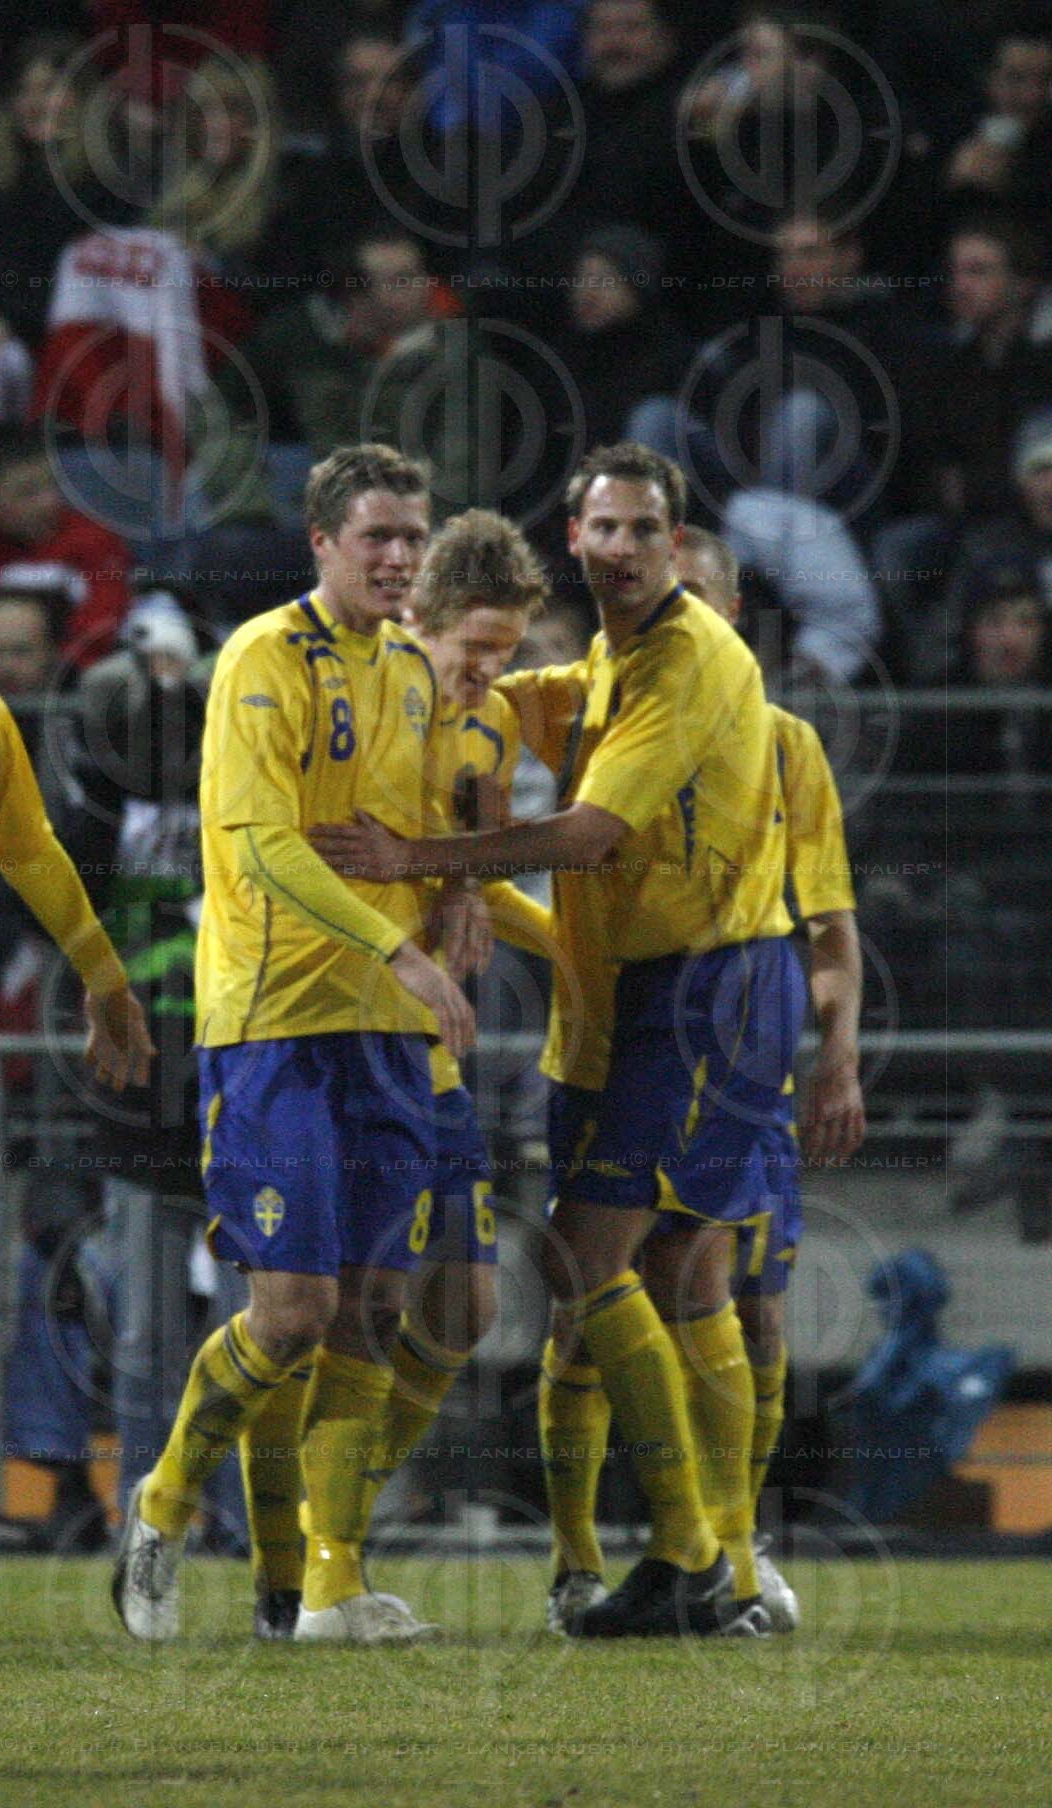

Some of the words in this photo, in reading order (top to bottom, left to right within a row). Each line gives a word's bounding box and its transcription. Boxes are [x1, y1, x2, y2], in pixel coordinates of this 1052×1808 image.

[328, 698, 356, 762] 8
[408, 1188, 433, 1254] 8
[472, 1180, 497, 1246] 6
